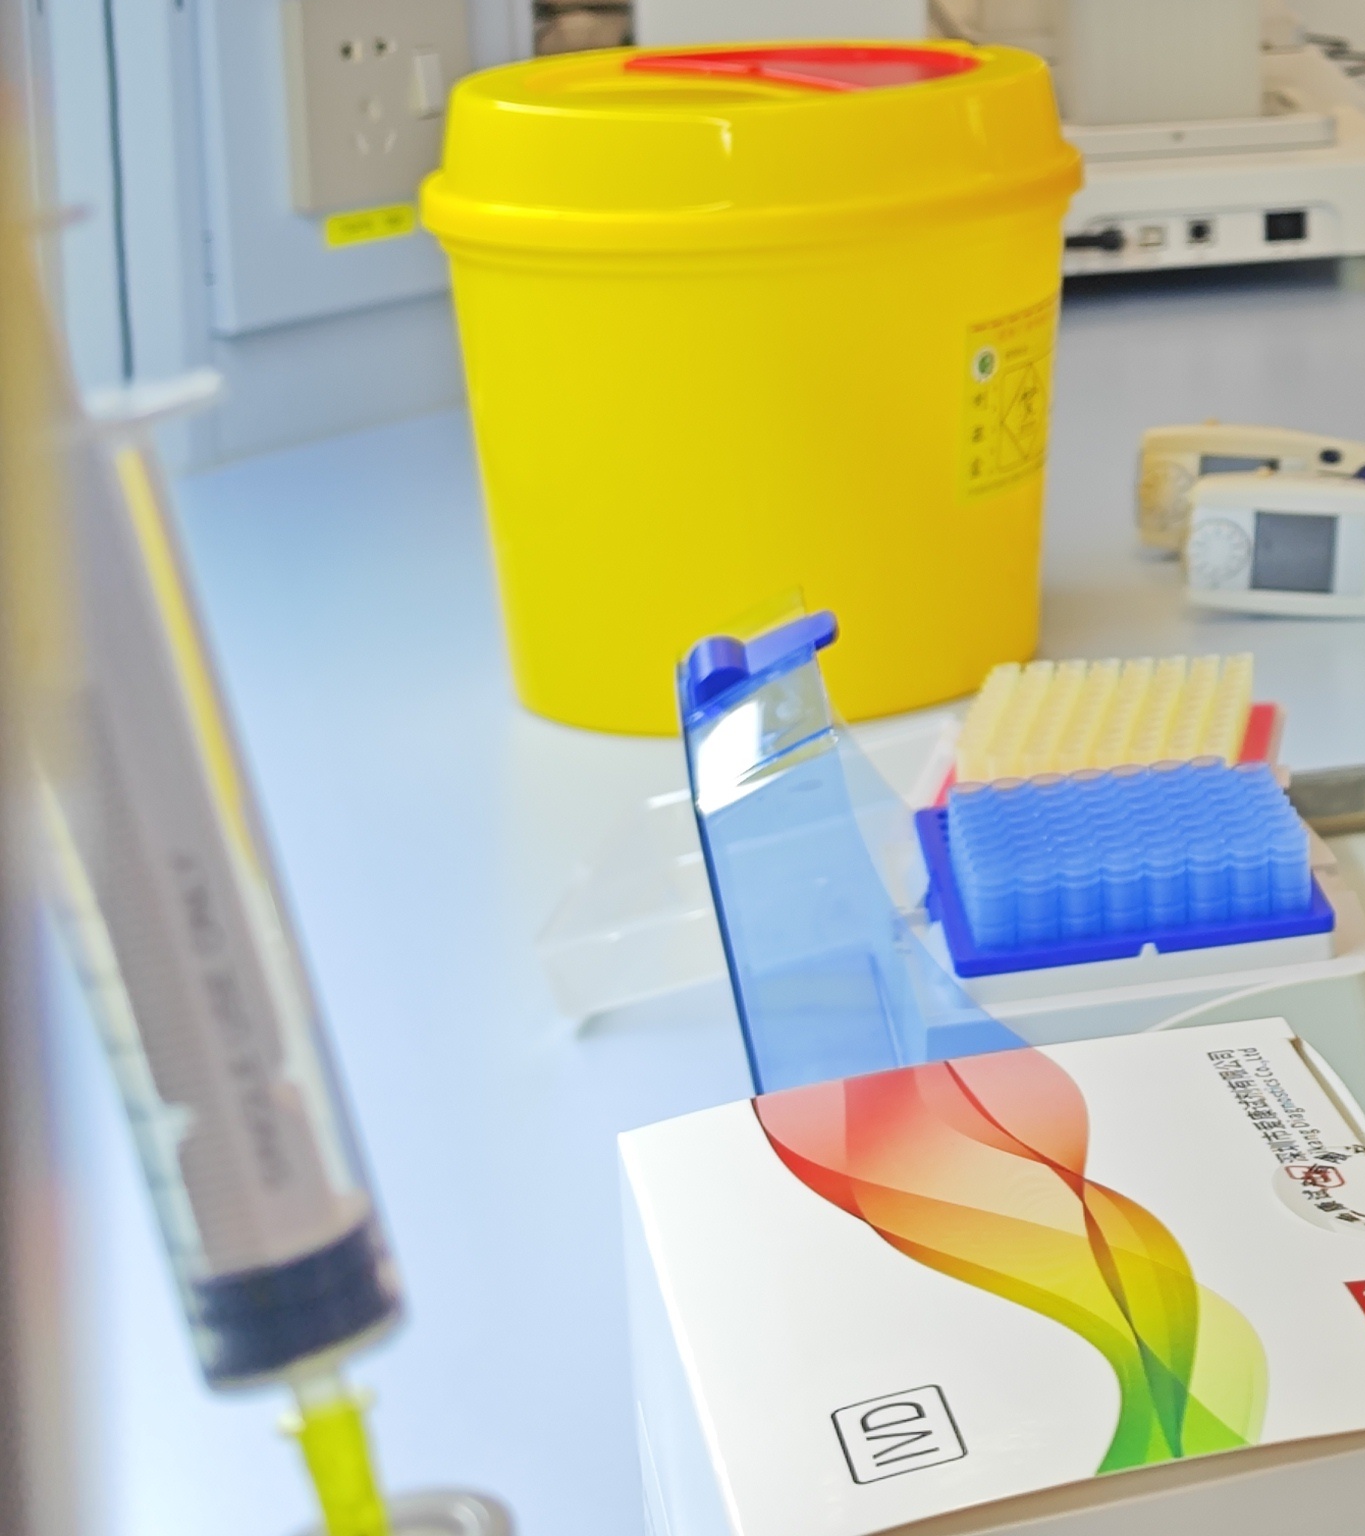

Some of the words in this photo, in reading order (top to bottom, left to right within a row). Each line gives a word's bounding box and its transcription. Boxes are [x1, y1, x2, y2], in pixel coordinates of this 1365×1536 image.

[1206, 1048, 1310, 1164] 深圳市爱康试剂有限公司
[1261, 1078, 1311, 1129] Diagnostics
[859, 1399, 940, 1468] IVD
